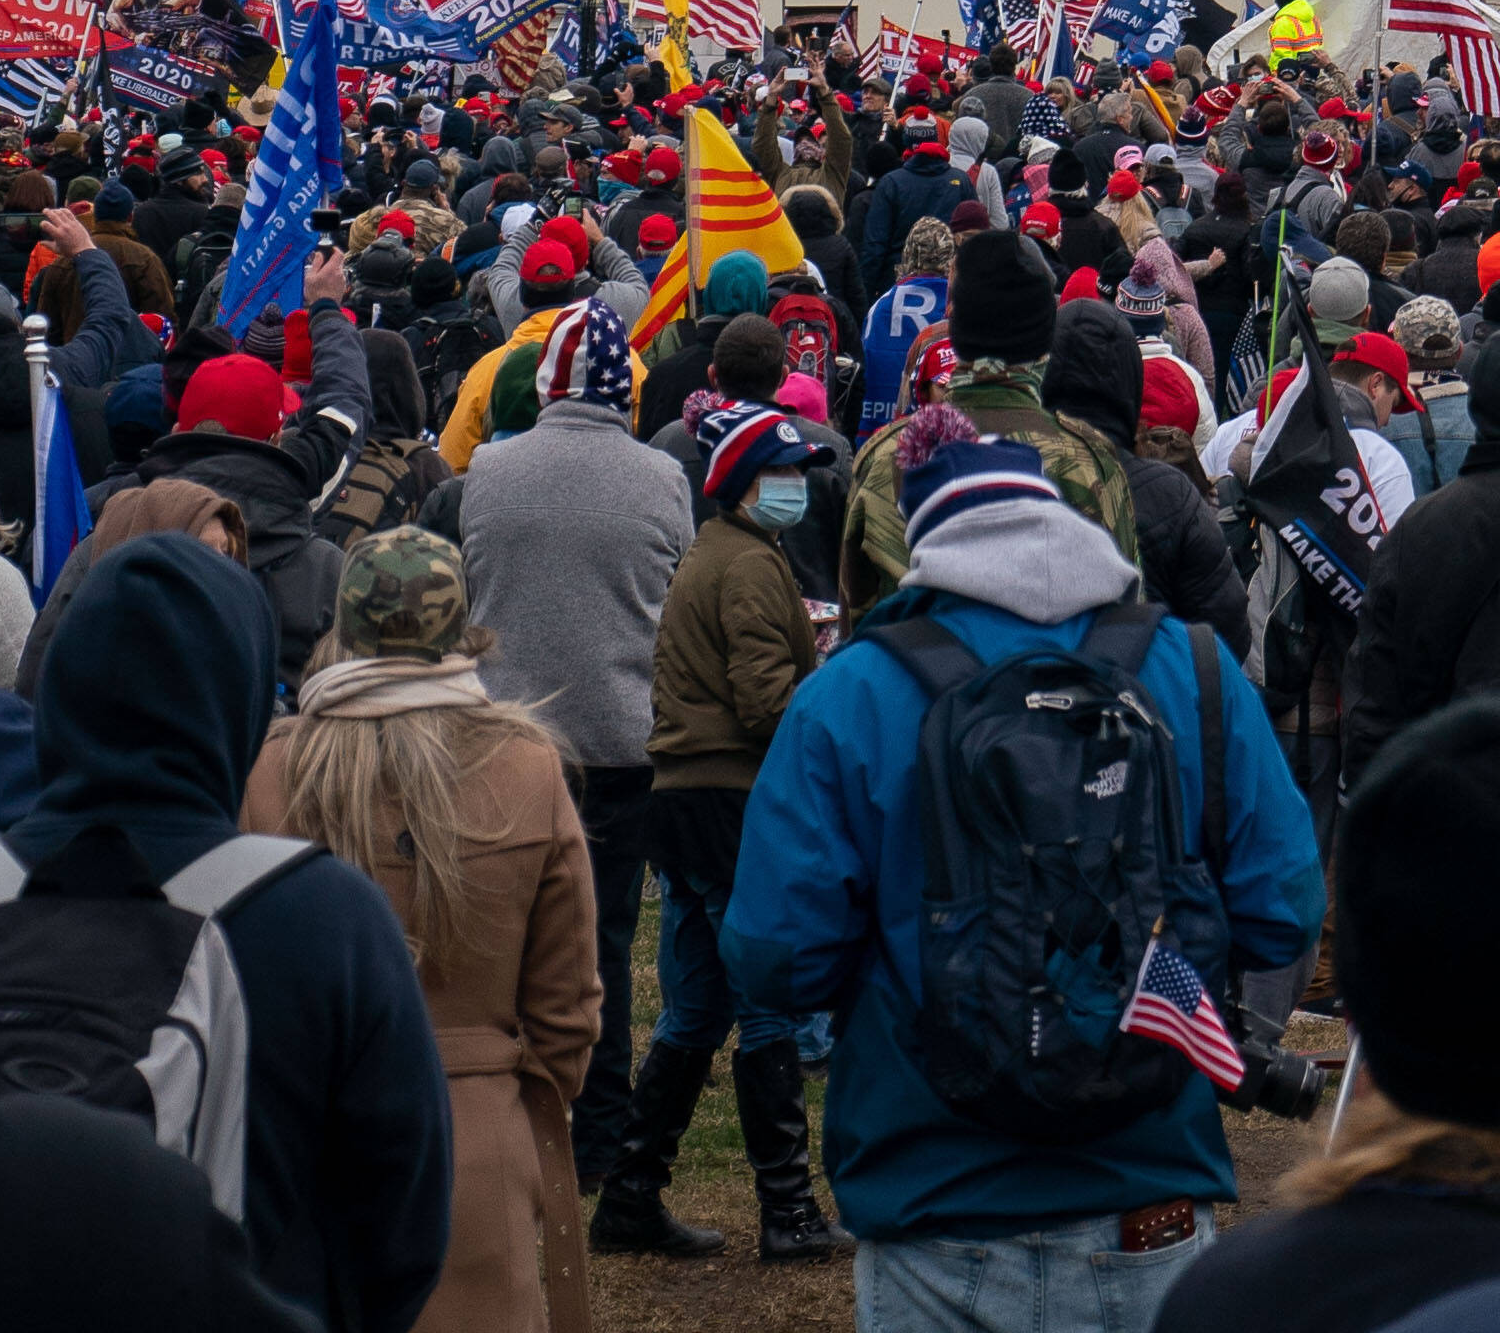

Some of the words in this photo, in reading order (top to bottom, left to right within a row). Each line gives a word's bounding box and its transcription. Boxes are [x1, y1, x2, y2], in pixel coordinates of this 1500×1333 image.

[108, 73, 132, 91] AKE
[131, 79, 170, 104] LIBERALS
[137, 57, 193, 90] 2020
[1279, 522, 1332, 586] MAKE
